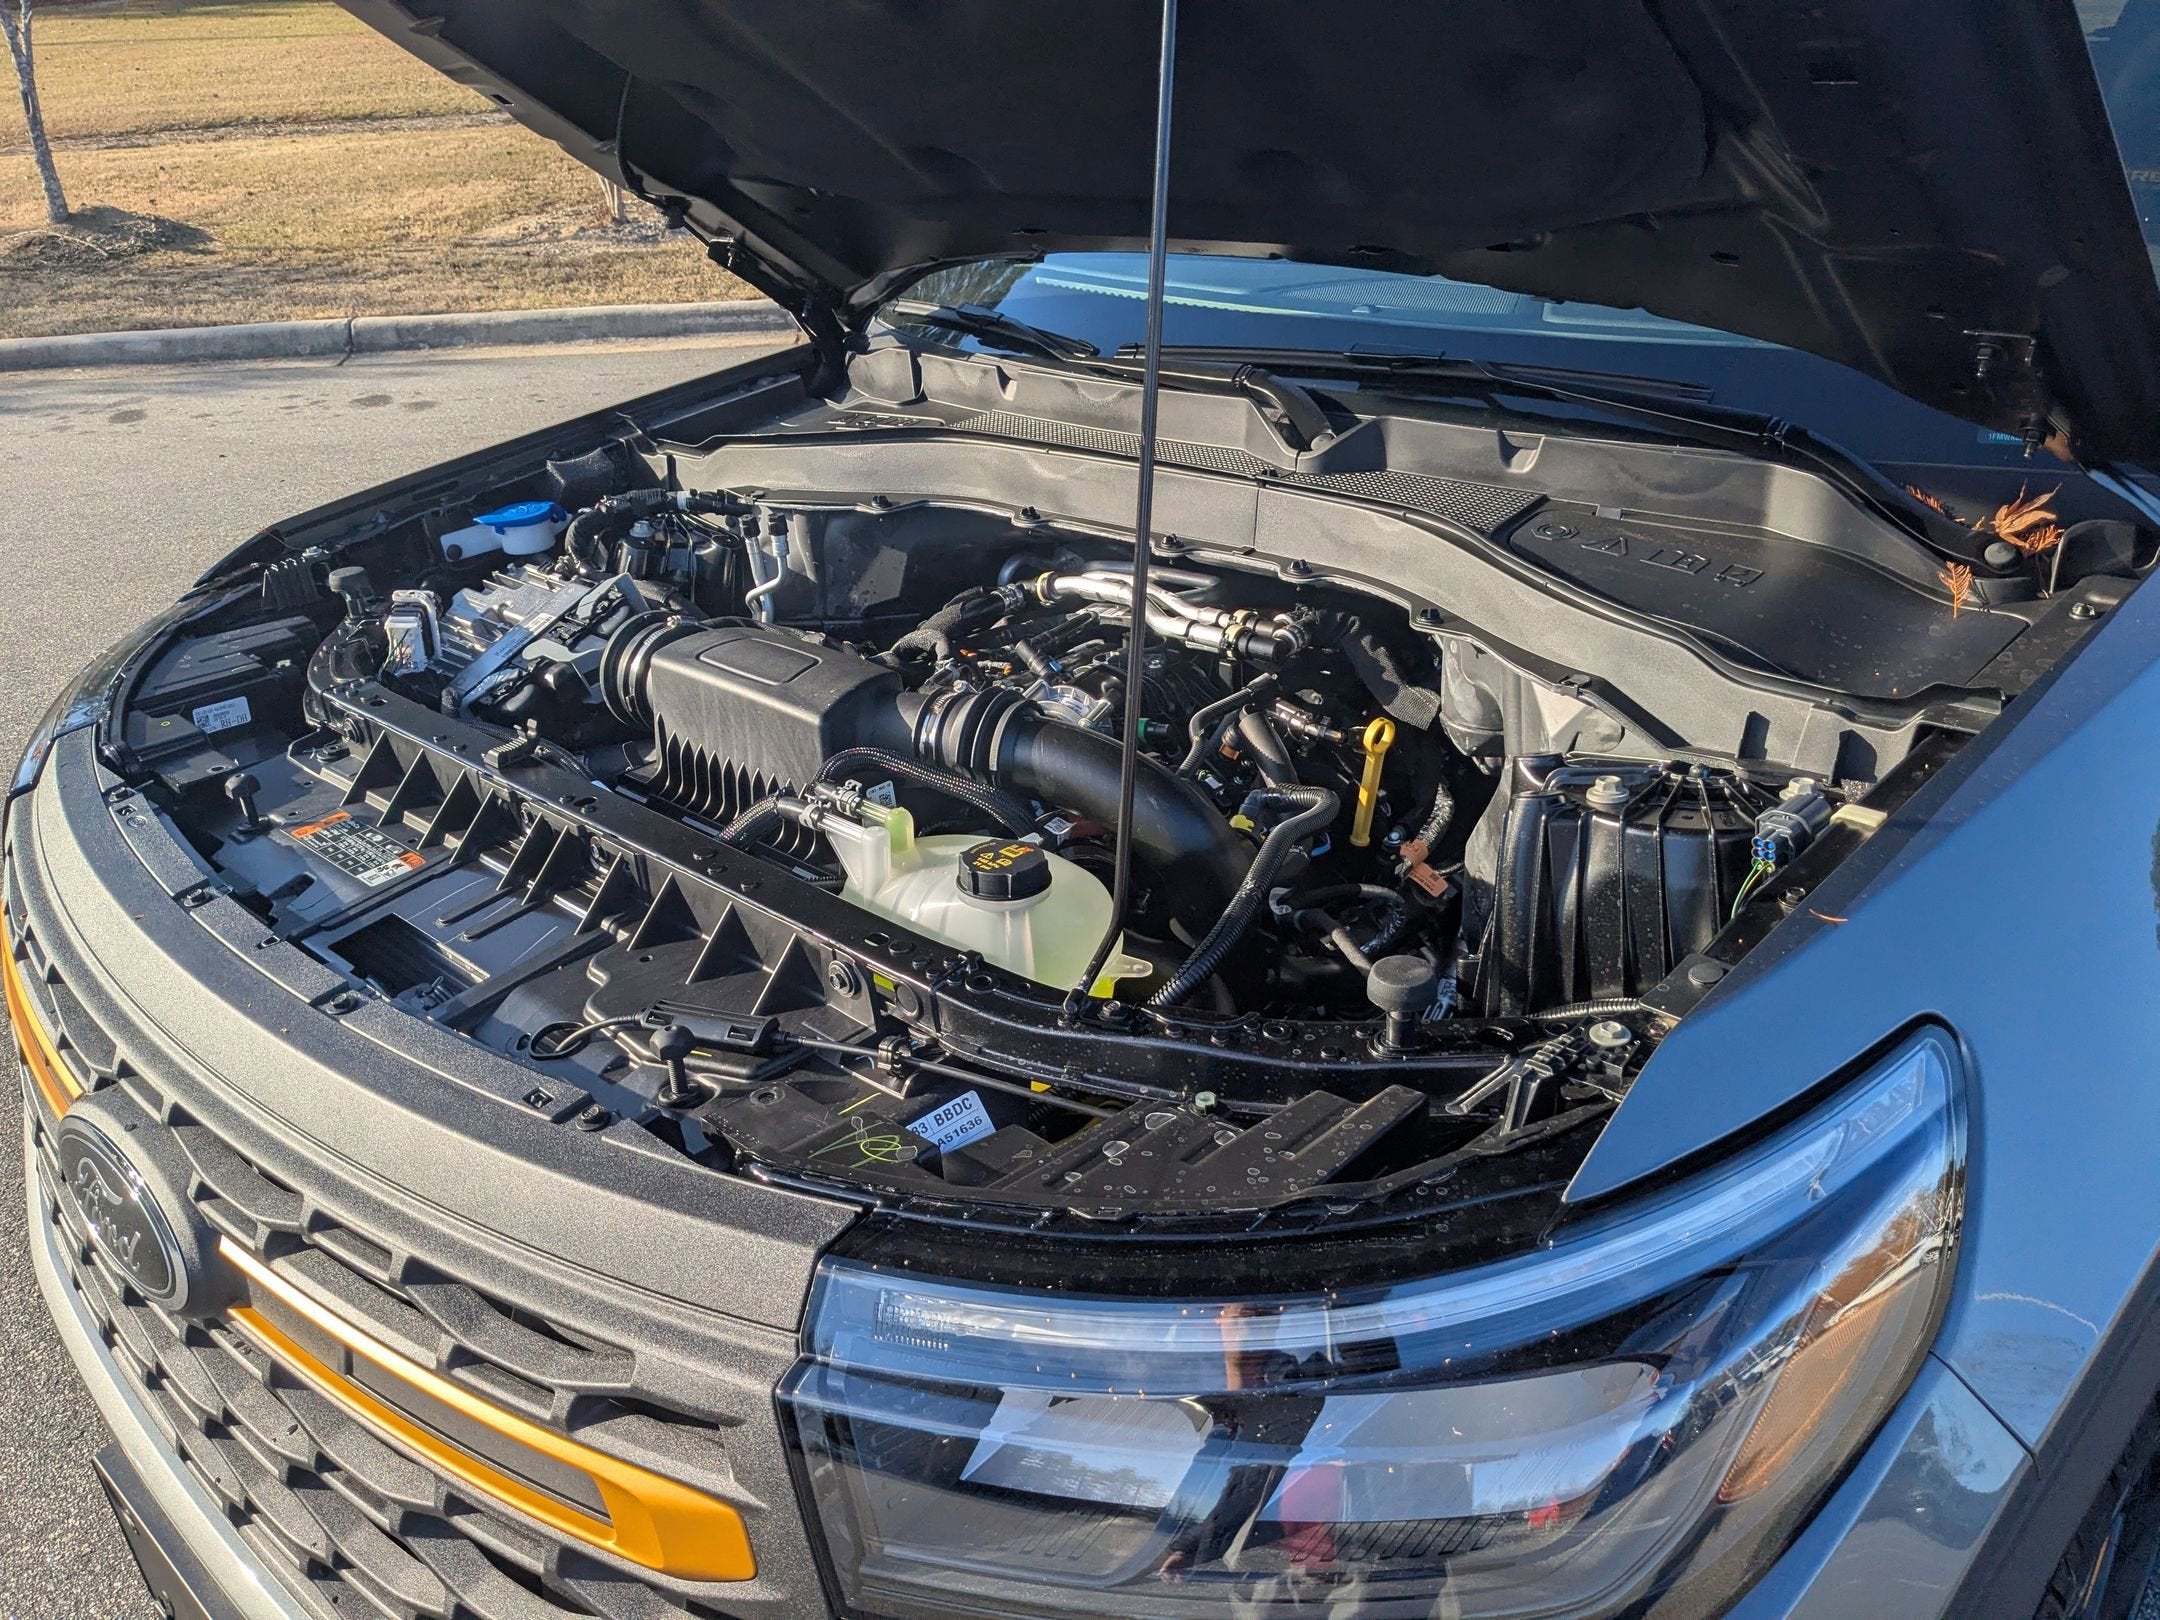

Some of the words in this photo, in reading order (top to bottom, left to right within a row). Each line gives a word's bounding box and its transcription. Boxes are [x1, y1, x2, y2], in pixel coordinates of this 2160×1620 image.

[220, 713, 248, 728] RH-DH
[933, 1097, 973, 1127] BBDC
[937, 1115, 983, 1147] A51636
[74, 1157, 141, 1273] Ford
